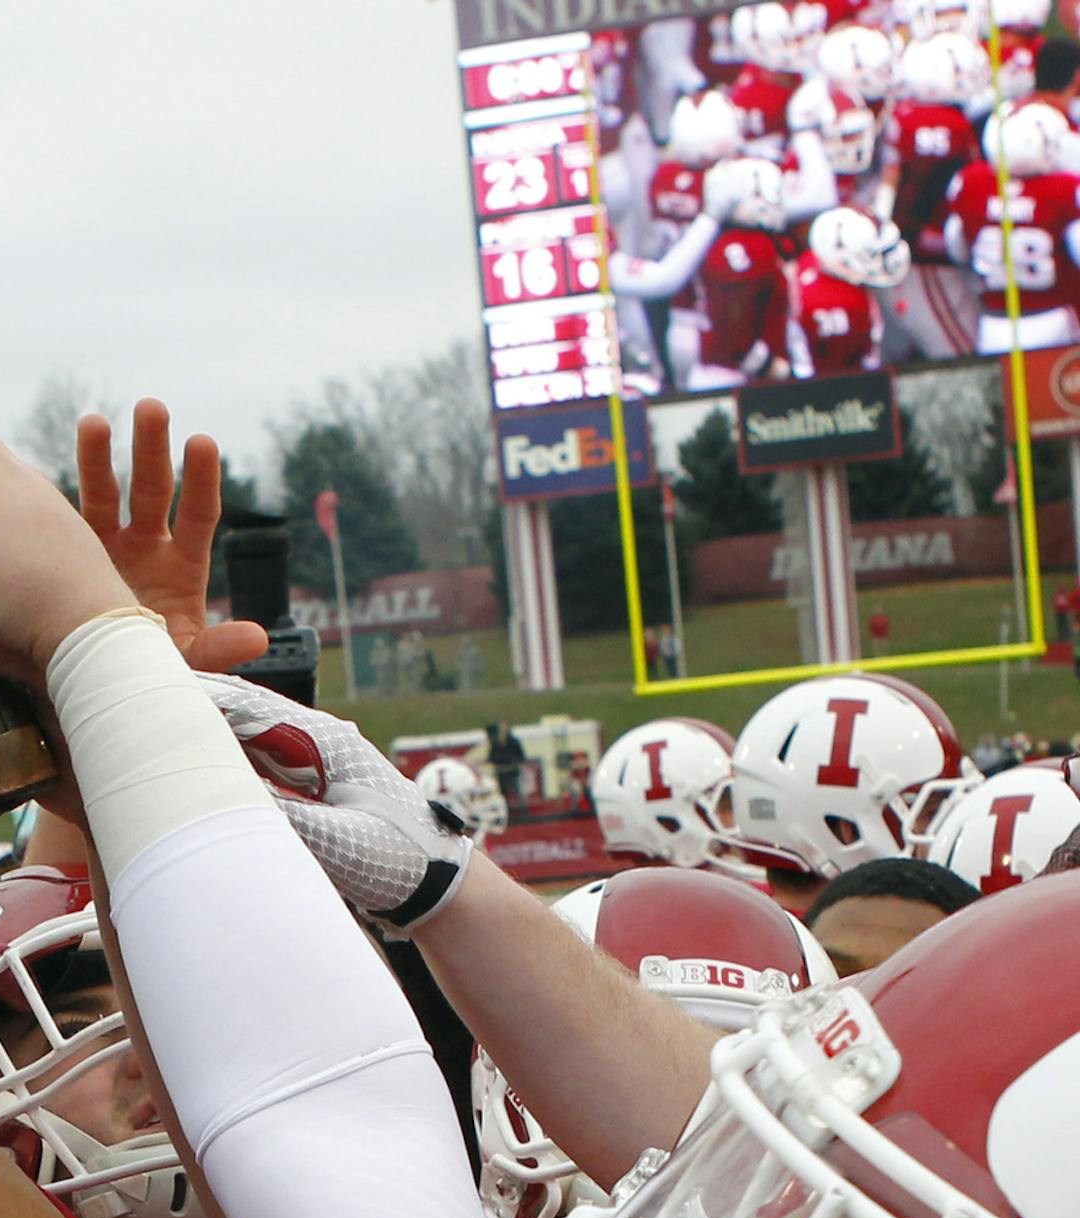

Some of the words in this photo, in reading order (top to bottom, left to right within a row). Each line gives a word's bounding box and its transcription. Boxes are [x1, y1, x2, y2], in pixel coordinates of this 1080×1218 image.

[482, 155, 549, 211] 23
[492, 247, 558, 299] 16
[641, 740, 672, 801] I
[816, 698, 869, 788] I
[979, 794, 1035, 897] I
